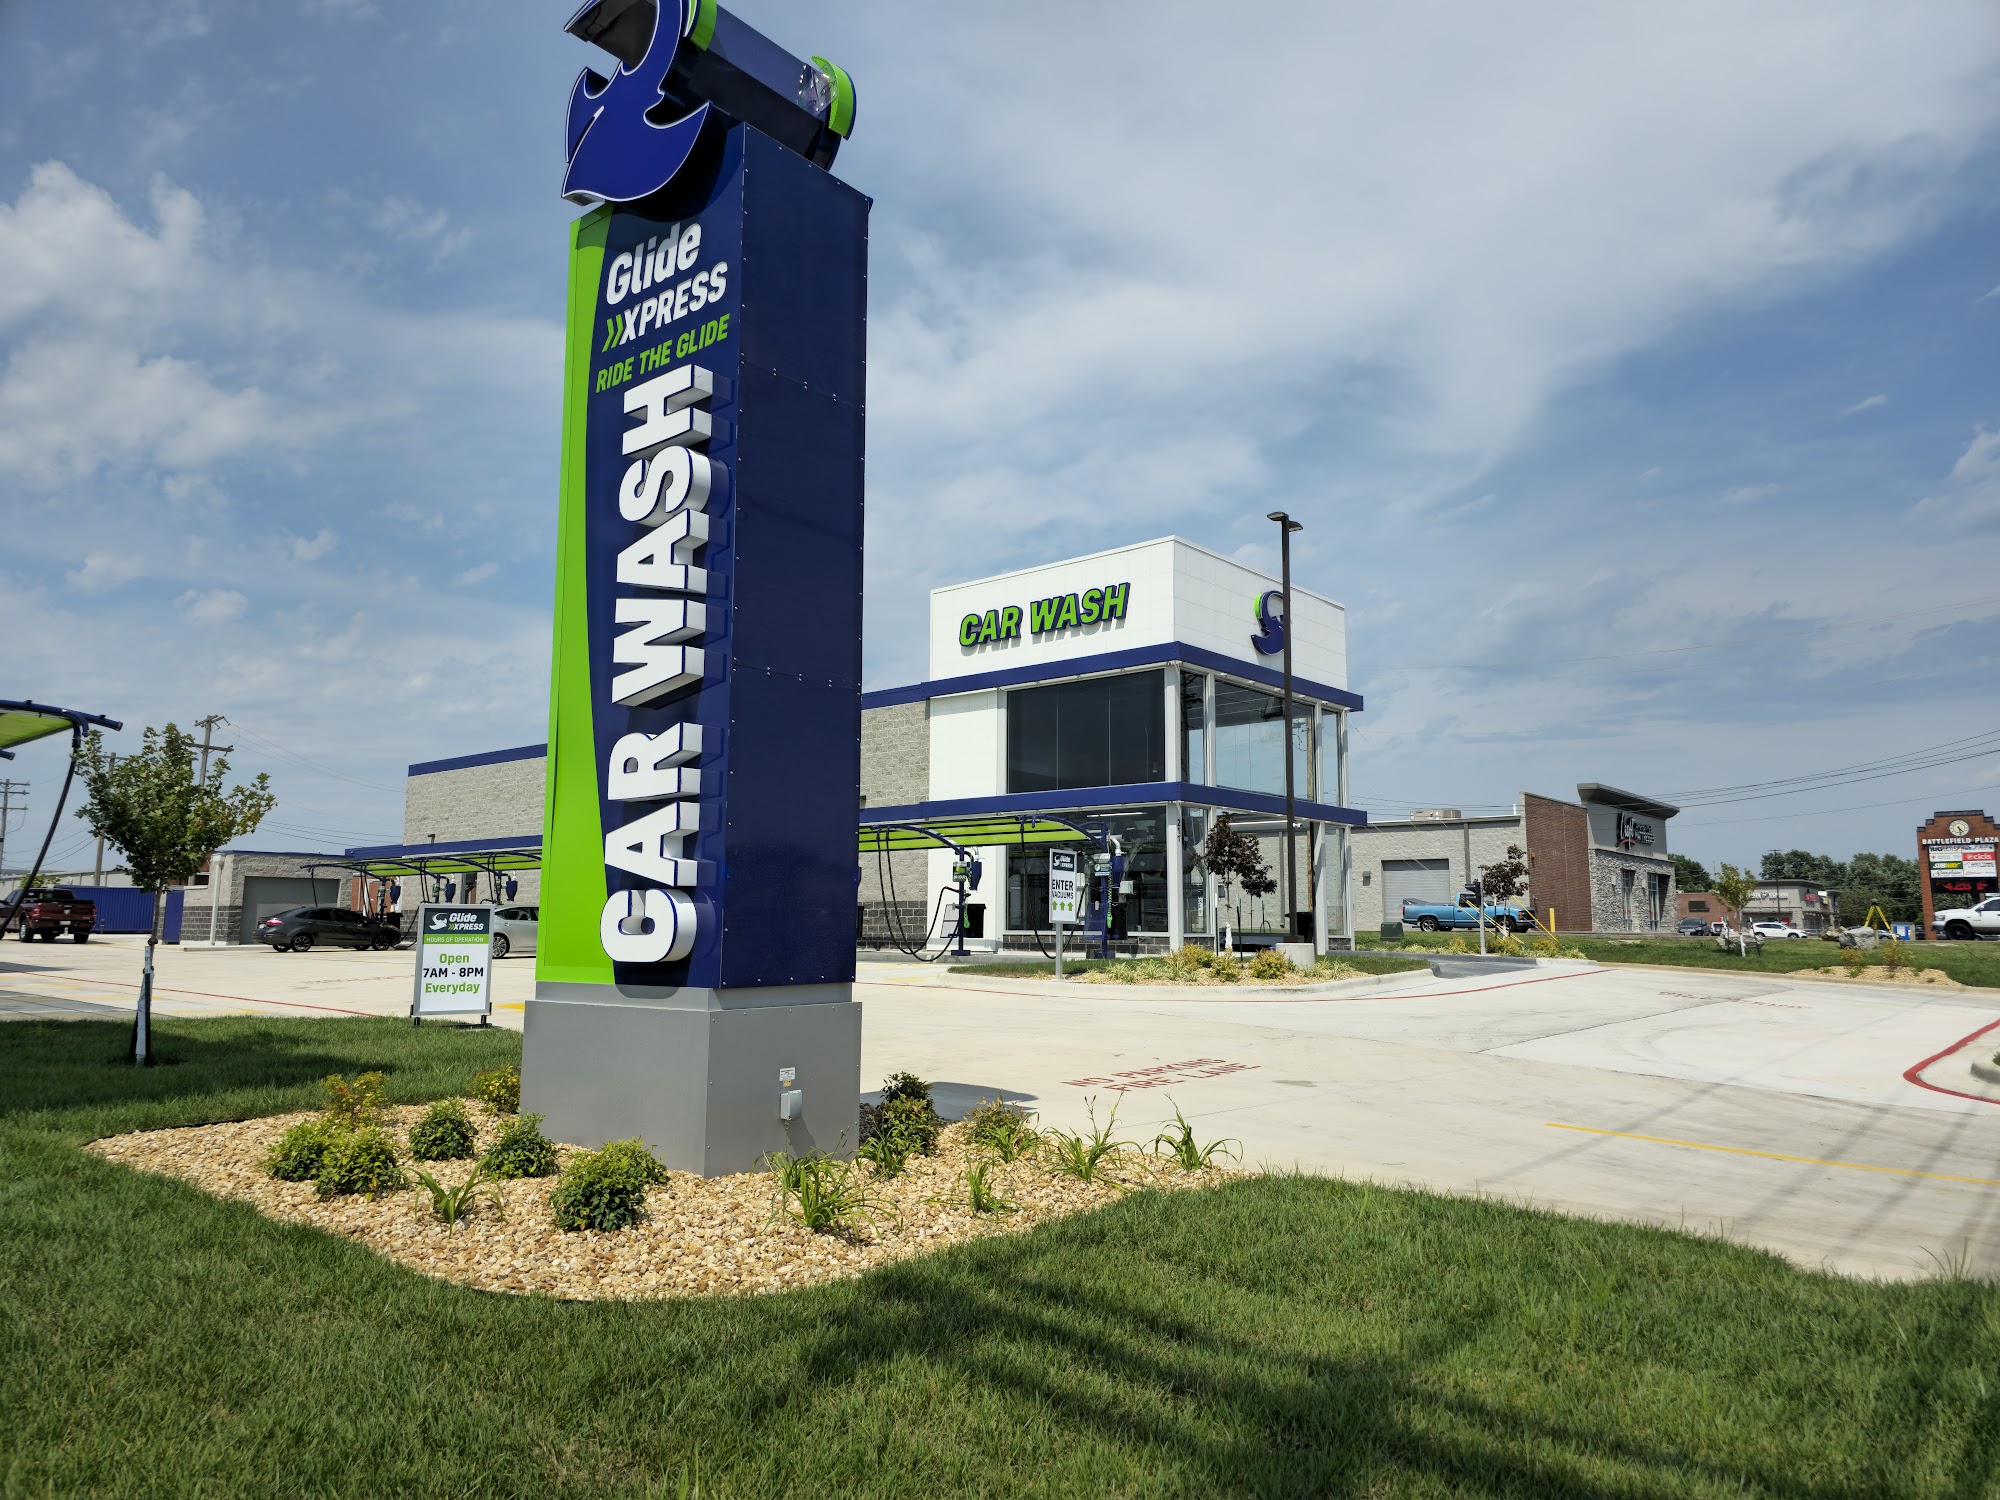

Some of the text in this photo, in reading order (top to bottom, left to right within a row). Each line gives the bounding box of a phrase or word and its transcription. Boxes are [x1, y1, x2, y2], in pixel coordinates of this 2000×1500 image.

[606, 222, 702, 305] Glide
[618, 260, 728, 346] XPRESS
[595, 313, 731, 394] RIDE THE GLIDE
[958, 582, 1131, 648] CAR WASH
[600, 364, 712, 963] CAR WASH
[1052, 879, 1074, 891] ENTER
[1052, 891, 1074, 899] VACUUMS
[449, 912, 478, 922] Glide
[453, 923, 484, 931] XPRESS
[439, 953, 470, 965] Open
[423, 967, 448, 978] 7AM
[459, 967, 484, 978] 8PM
[425, 982, 481, 994] Everyday
[1061, 1058, 1227, 1087] NO PARKING
[1102, 1062, 1261, 1092] FIRE LANE
